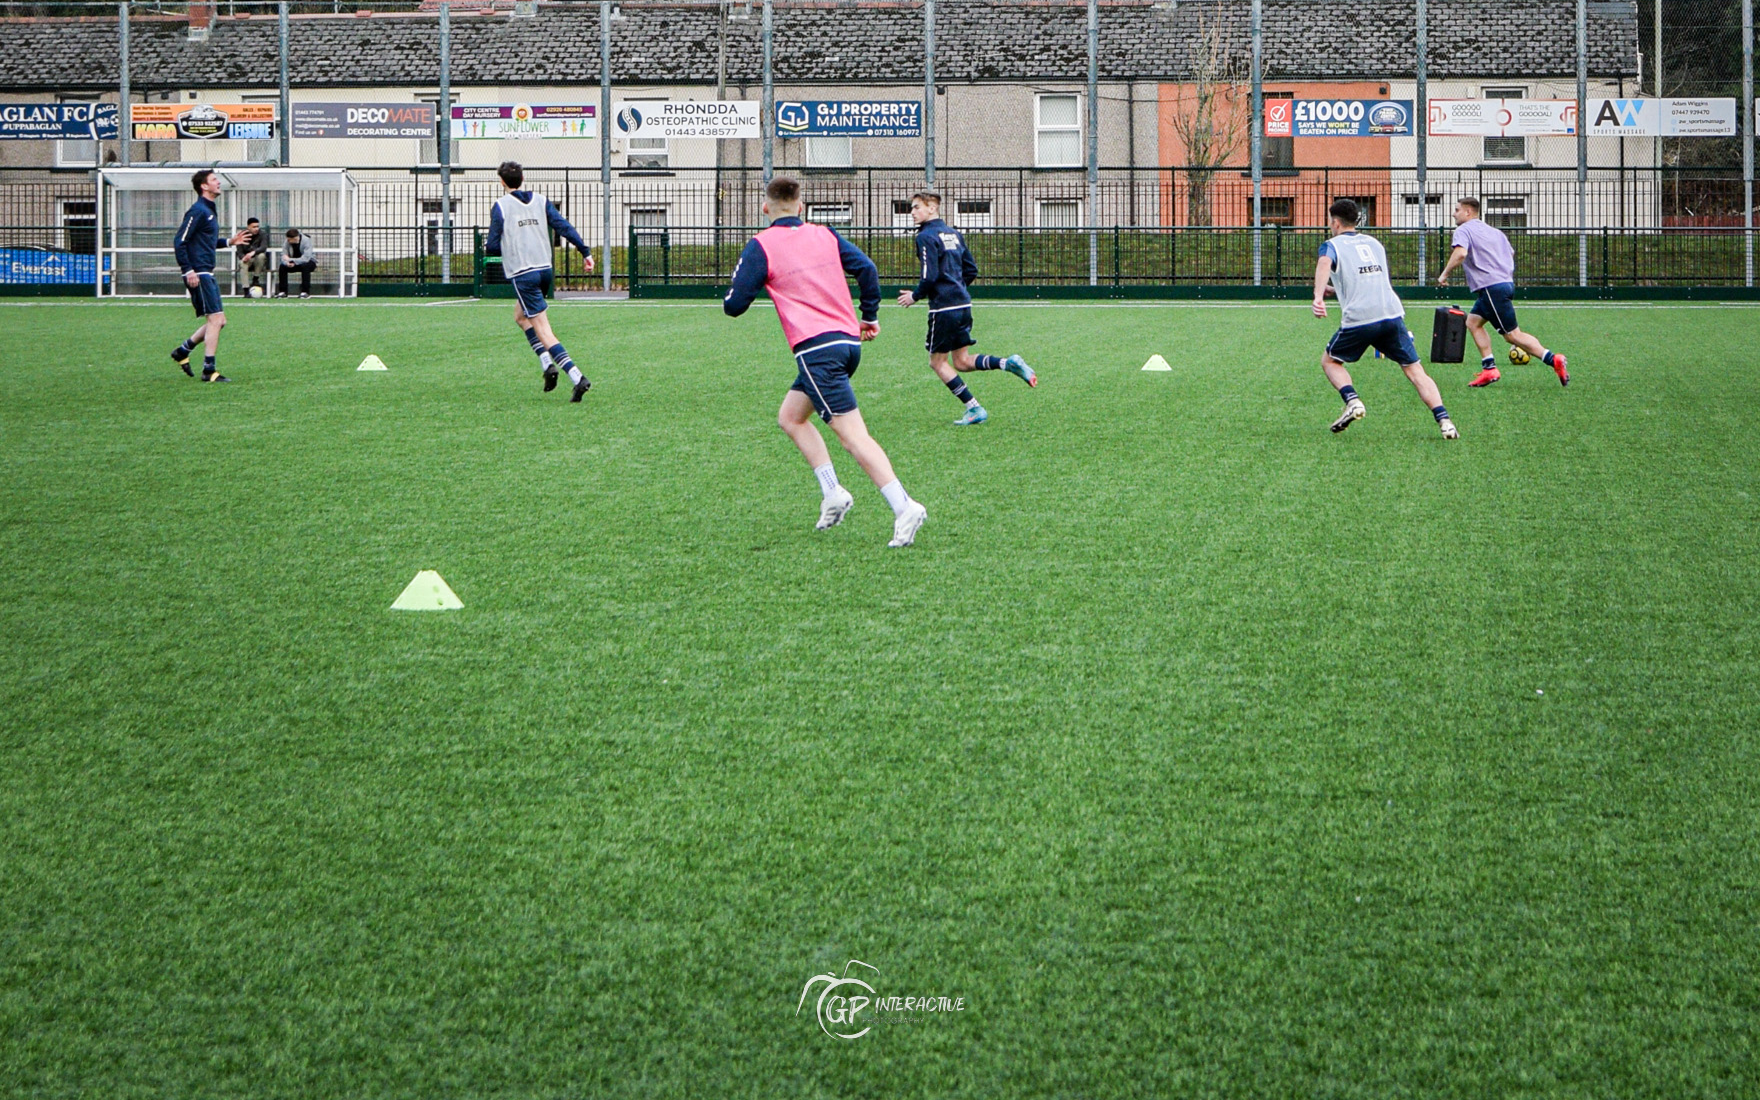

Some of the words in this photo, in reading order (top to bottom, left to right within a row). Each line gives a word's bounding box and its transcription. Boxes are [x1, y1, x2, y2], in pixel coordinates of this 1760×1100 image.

[62, 106, 88, 122] FC
[664, 104, 738, 114] RHONDDA
[817, 103, 838, 115] GJ
[841, 103, 919, 115] PROPERTY
[1295, 101, 1365, 121] £1000
[499, 121, 550, 133] SUNFLOWER
[646, 117, 719, 126] OSTEOPATHIC
[721, 116, 756, 126] CLINIC
[817, 115, 918, 127] MAINTENANCE
[135, 123, 177, 139] KARA
[229, 123, 271, 139] LEISURE
[347, 128, 399, 136] DECORATING
[400, 128, 432, 136] CENTRE
[665, 128, 696, 136] 01443
[698, 128, 738, 136] 438577
